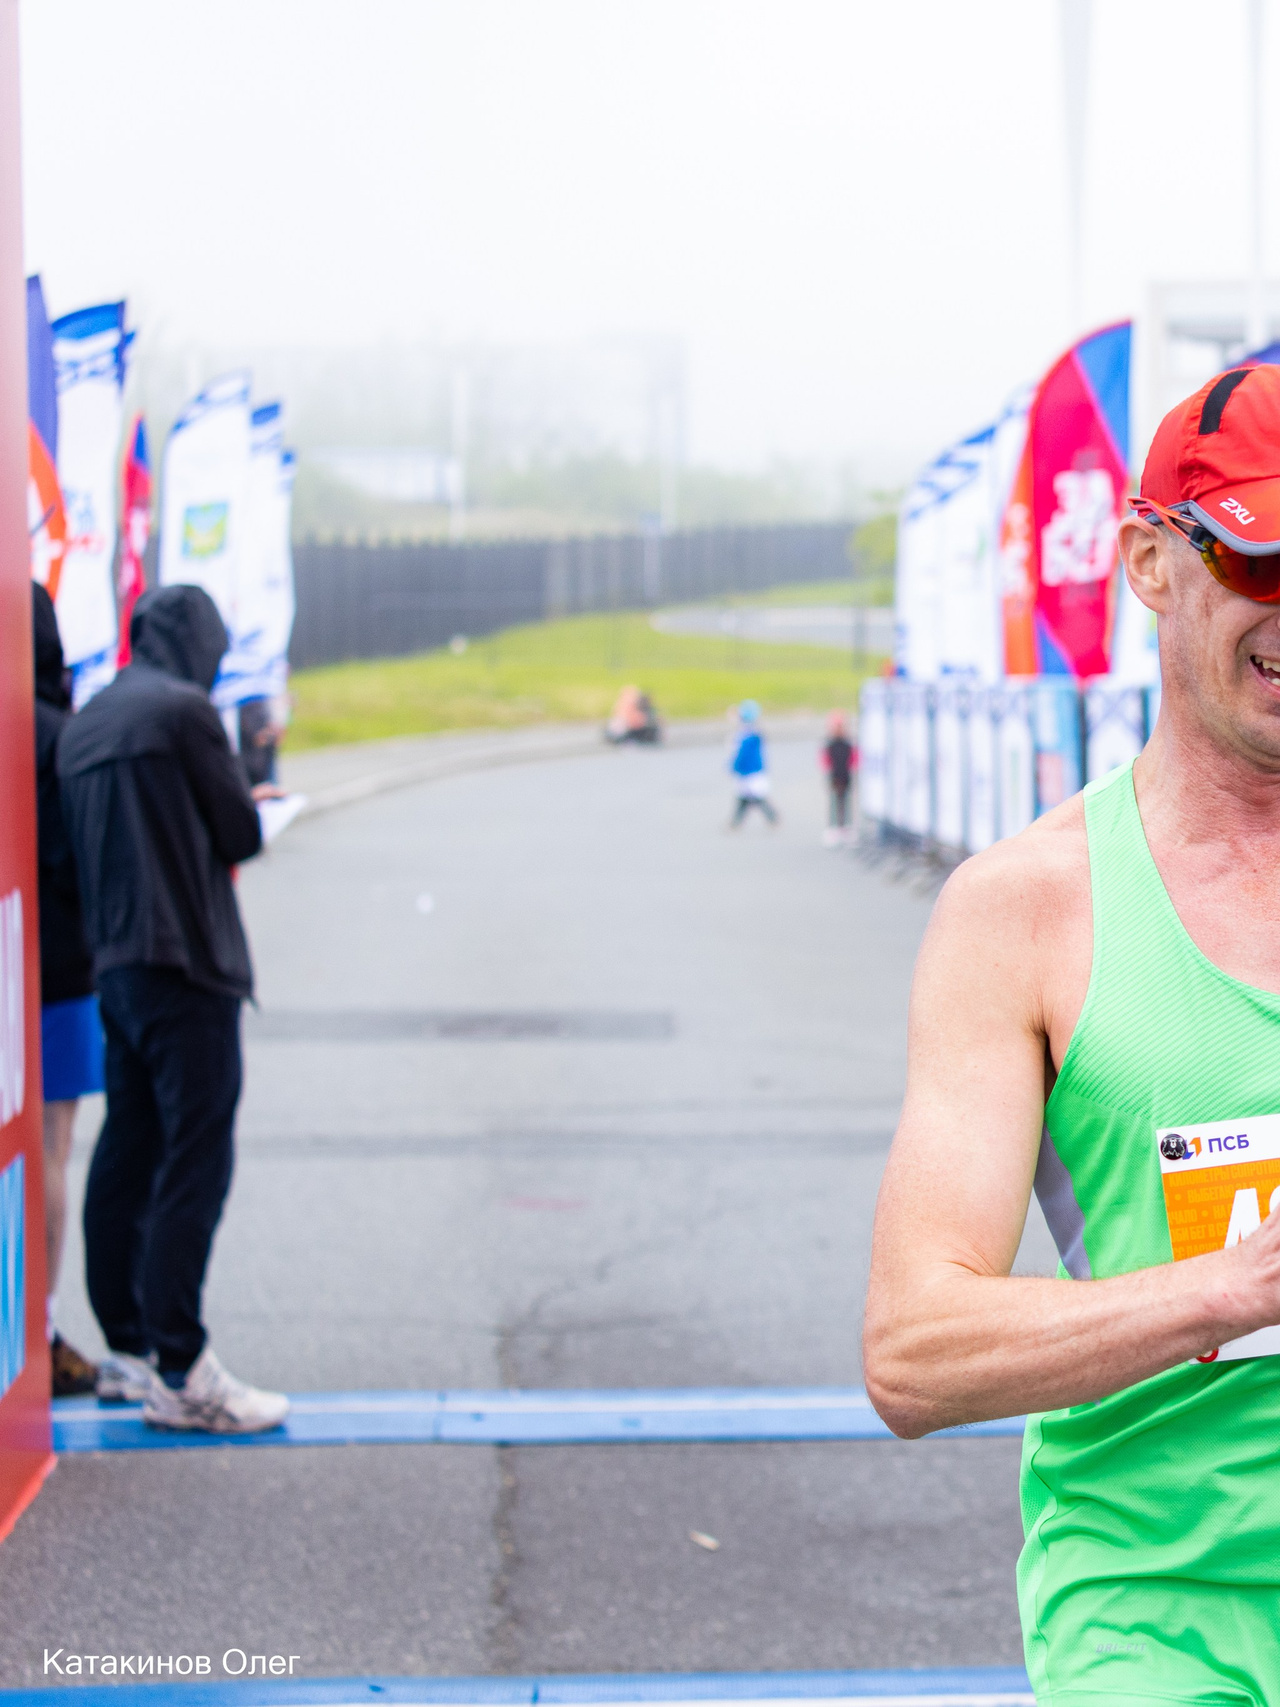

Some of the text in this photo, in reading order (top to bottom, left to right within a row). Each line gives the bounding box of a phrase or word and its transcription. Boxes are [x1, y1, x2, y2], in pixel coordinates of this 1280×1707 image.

[1219, 497, 1256, 525] 2XU
[1208, 1134, 1250, 1153] ПСБ
[1096, 1642, 1147, 1653] DRI-FIT
